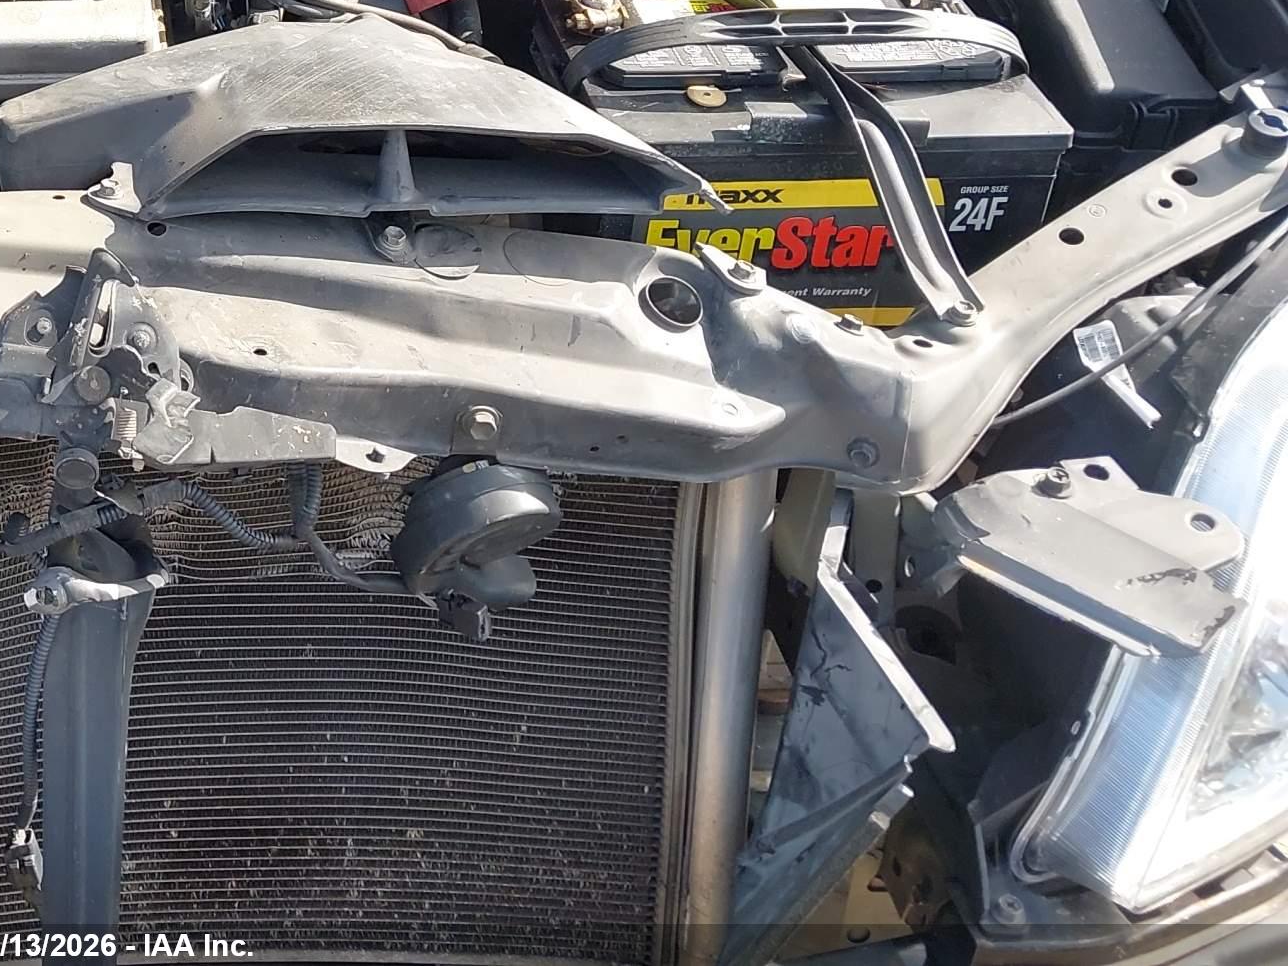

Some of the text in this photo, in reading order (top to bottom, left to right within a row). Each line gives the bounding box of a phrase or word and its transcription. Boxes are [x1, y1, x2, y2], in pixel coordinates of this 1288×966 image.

[960, 185, 1010, 194] GROUP SIZE
[948, 196, 1009, 232] 24F
[812, 287, 872, 298] Warranty
